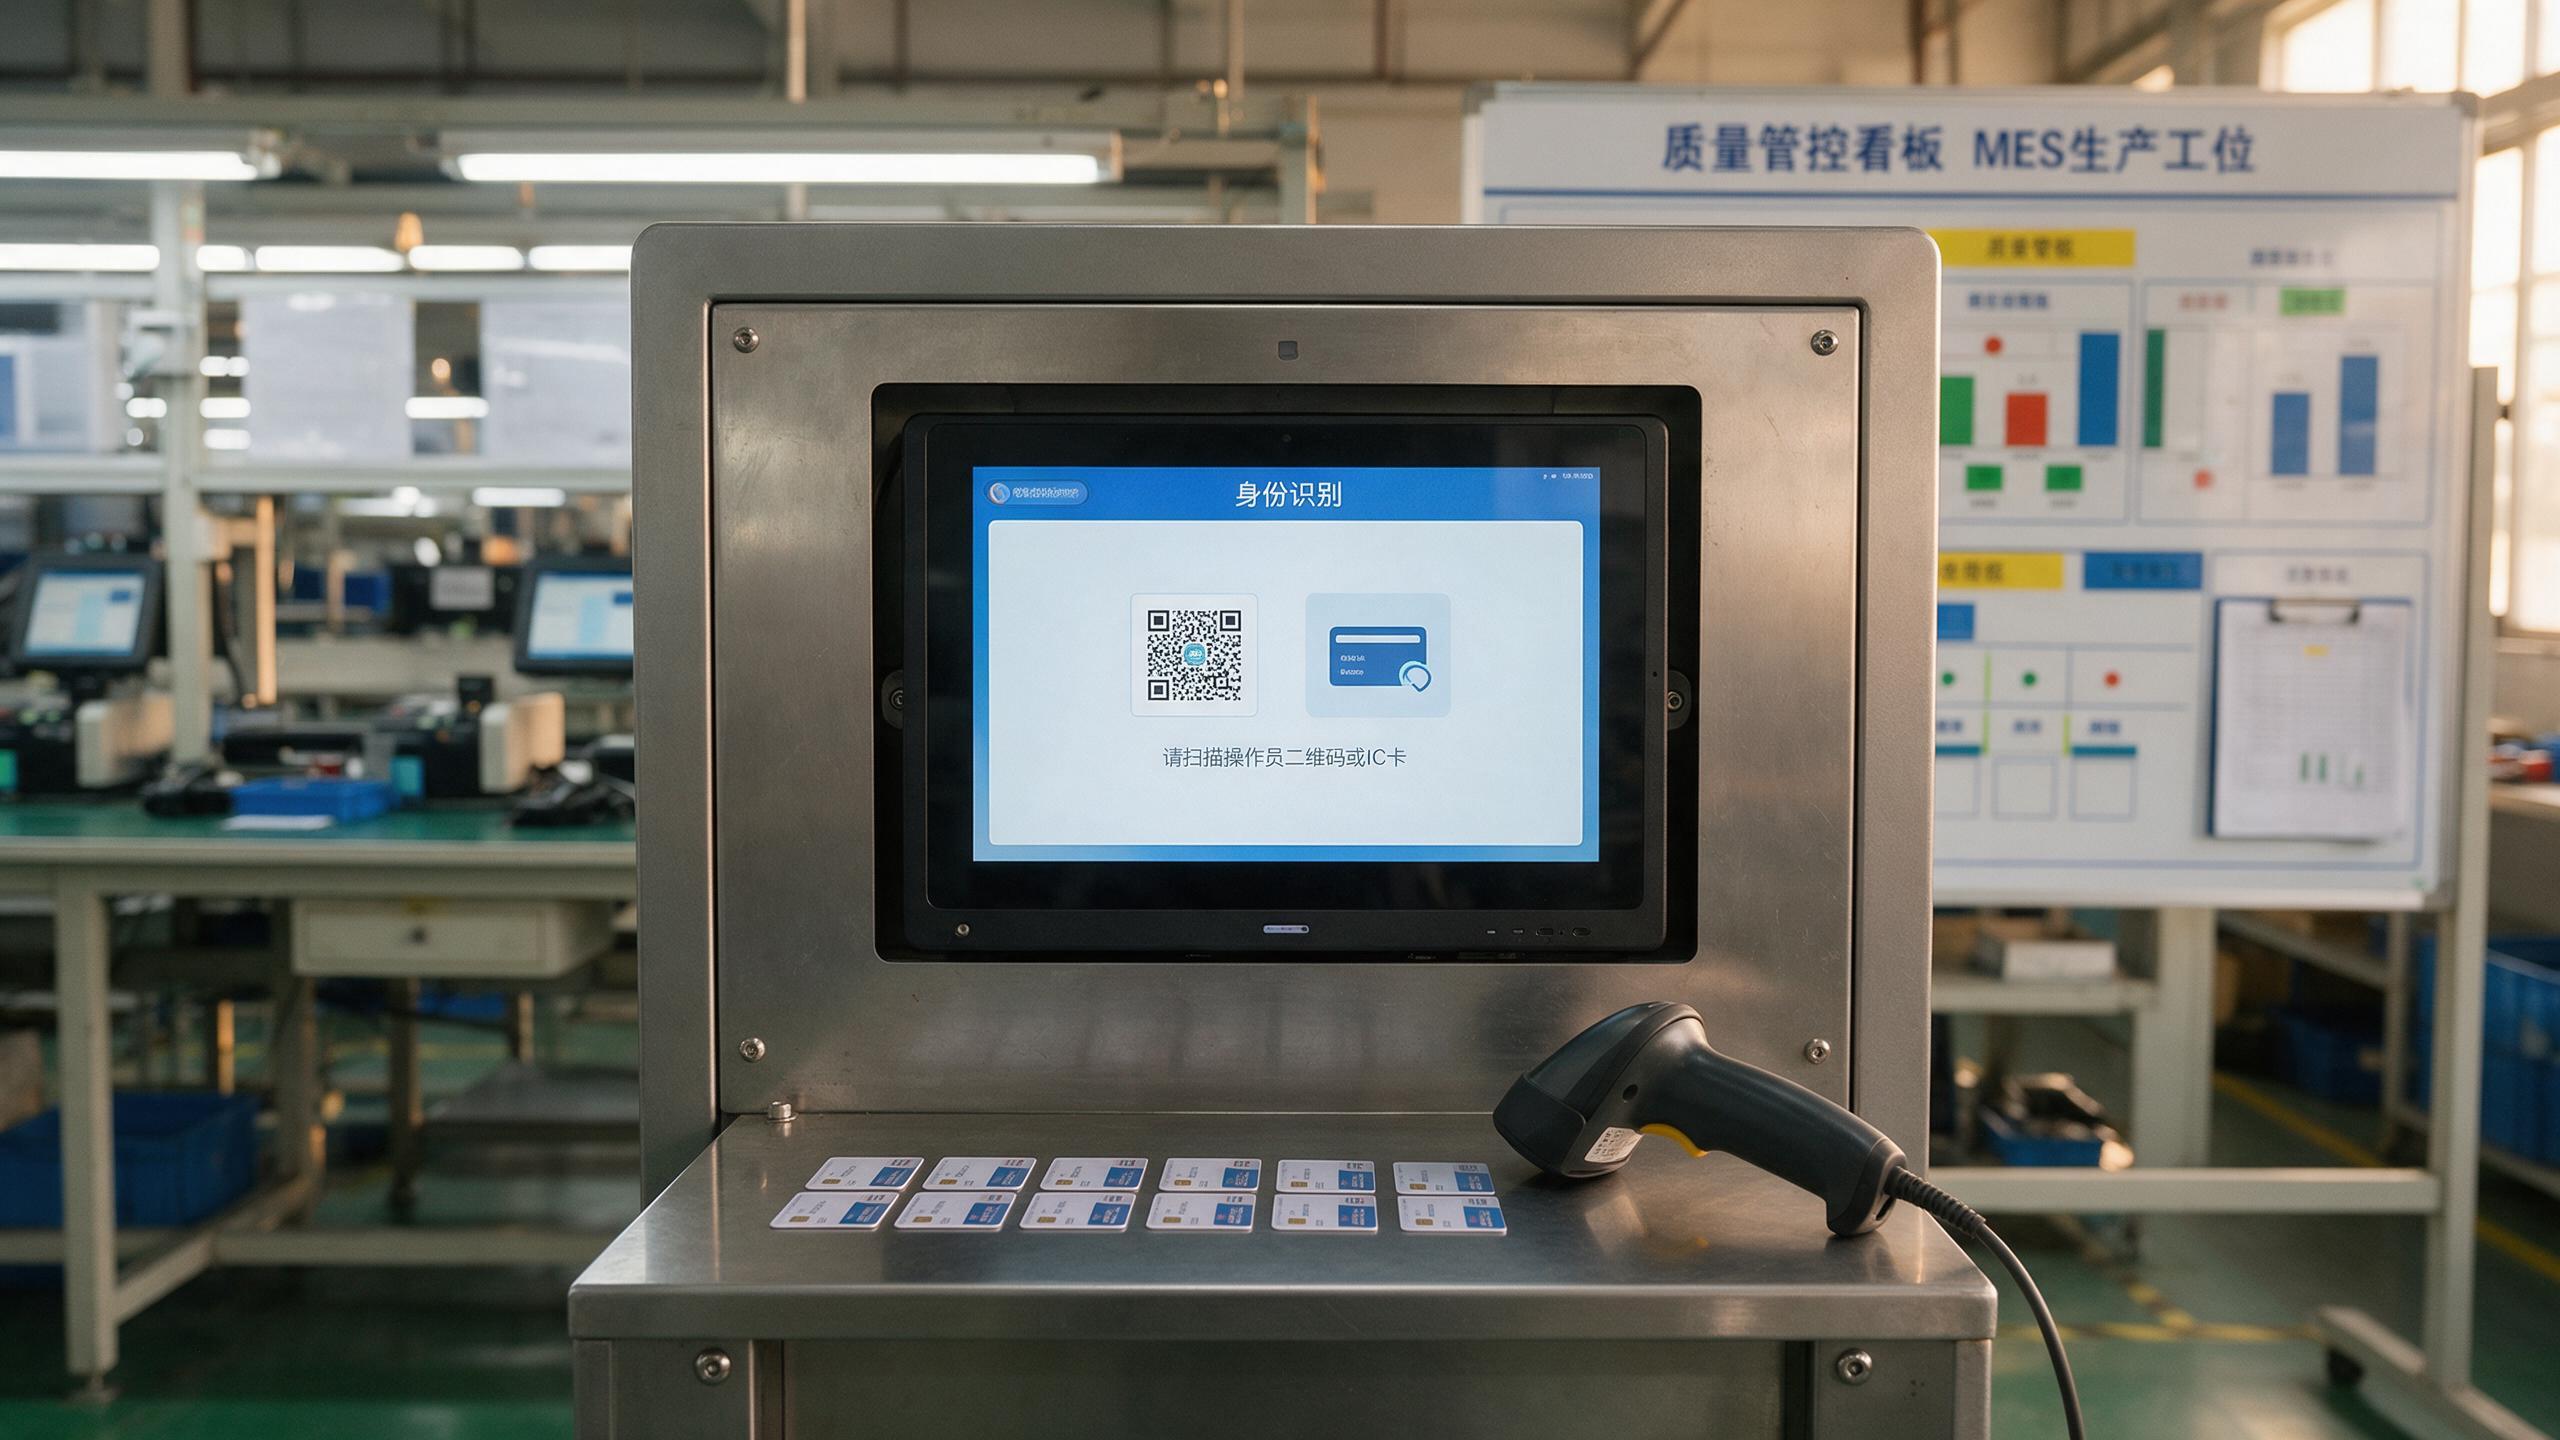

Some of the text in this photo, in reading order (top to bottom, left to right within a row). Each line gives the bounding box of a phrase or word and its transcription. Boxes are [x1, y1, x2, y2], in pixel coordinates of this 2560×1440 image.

[1662, 123, 2256, 174] 质量管控看板 MES生产工位
[1235, 480, 1342, 508] 身份识别
[1162, 747, 1408, 768] 请扫描操作员二维码或IC卡
